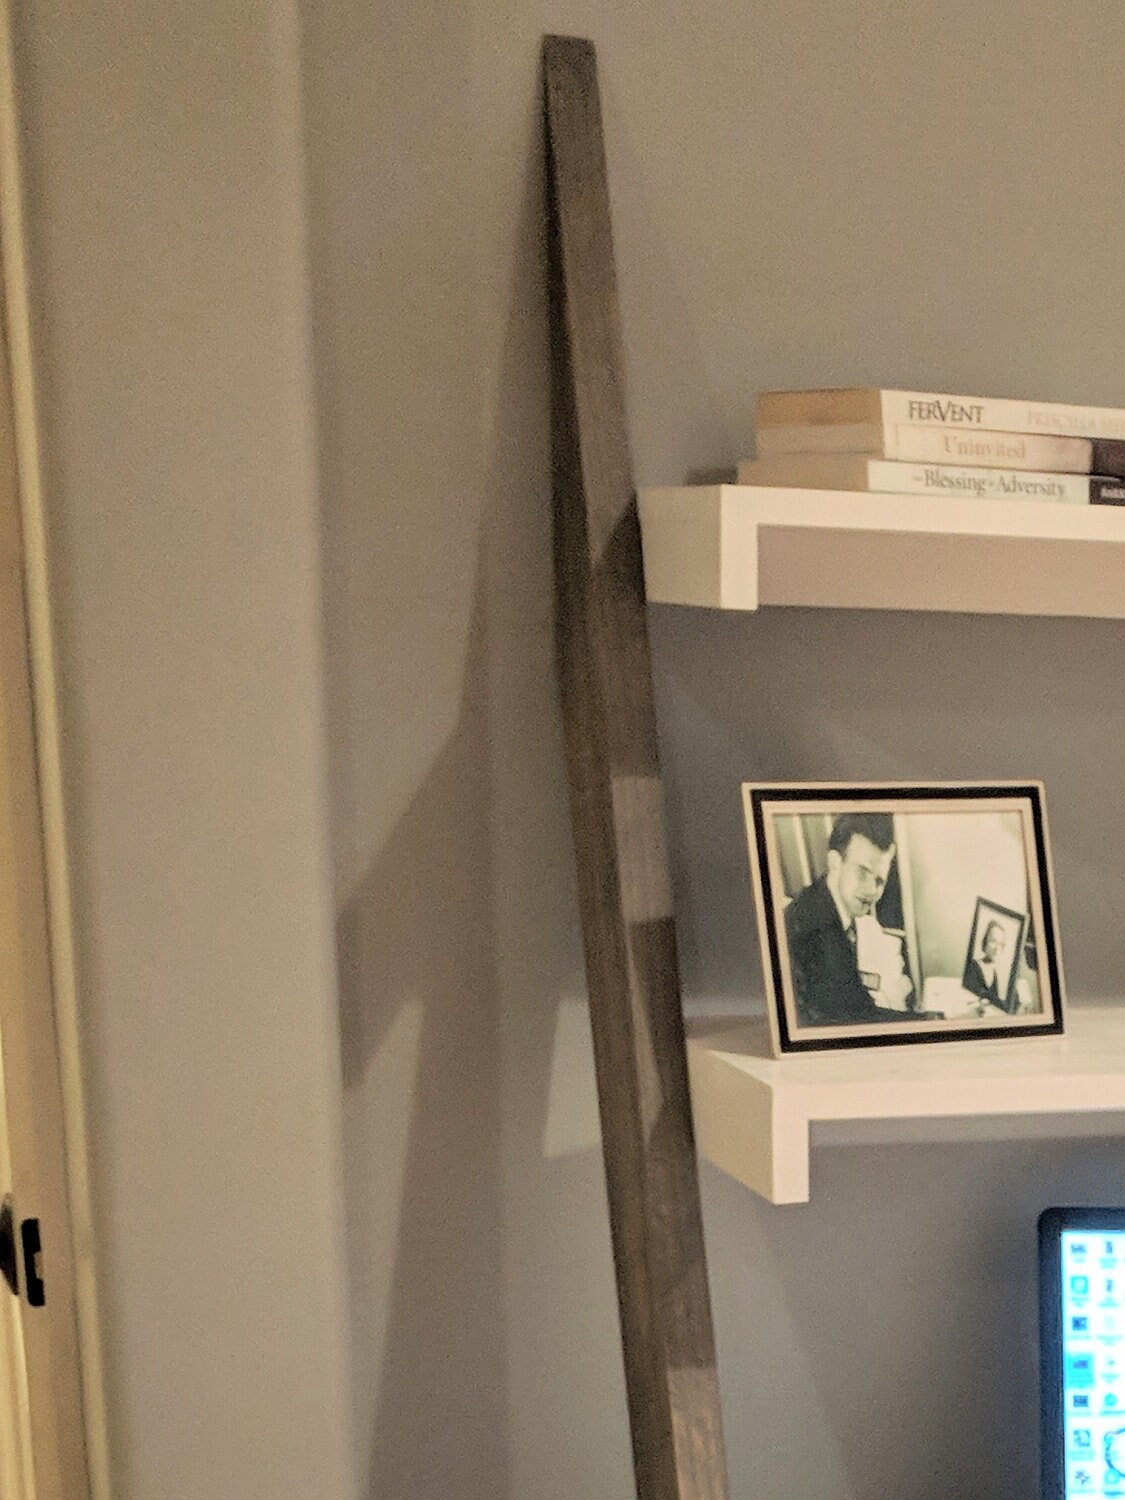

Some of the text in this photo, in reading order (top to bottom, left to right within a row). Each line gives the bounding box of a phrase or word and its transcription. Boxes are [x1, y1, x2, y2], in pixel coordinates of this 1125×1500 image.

[908, 400, 984, 423] FERVENT
[944, 434, 1026, 459] Uninvited
[924, 469, 1066, 498] Blessing Adversity
